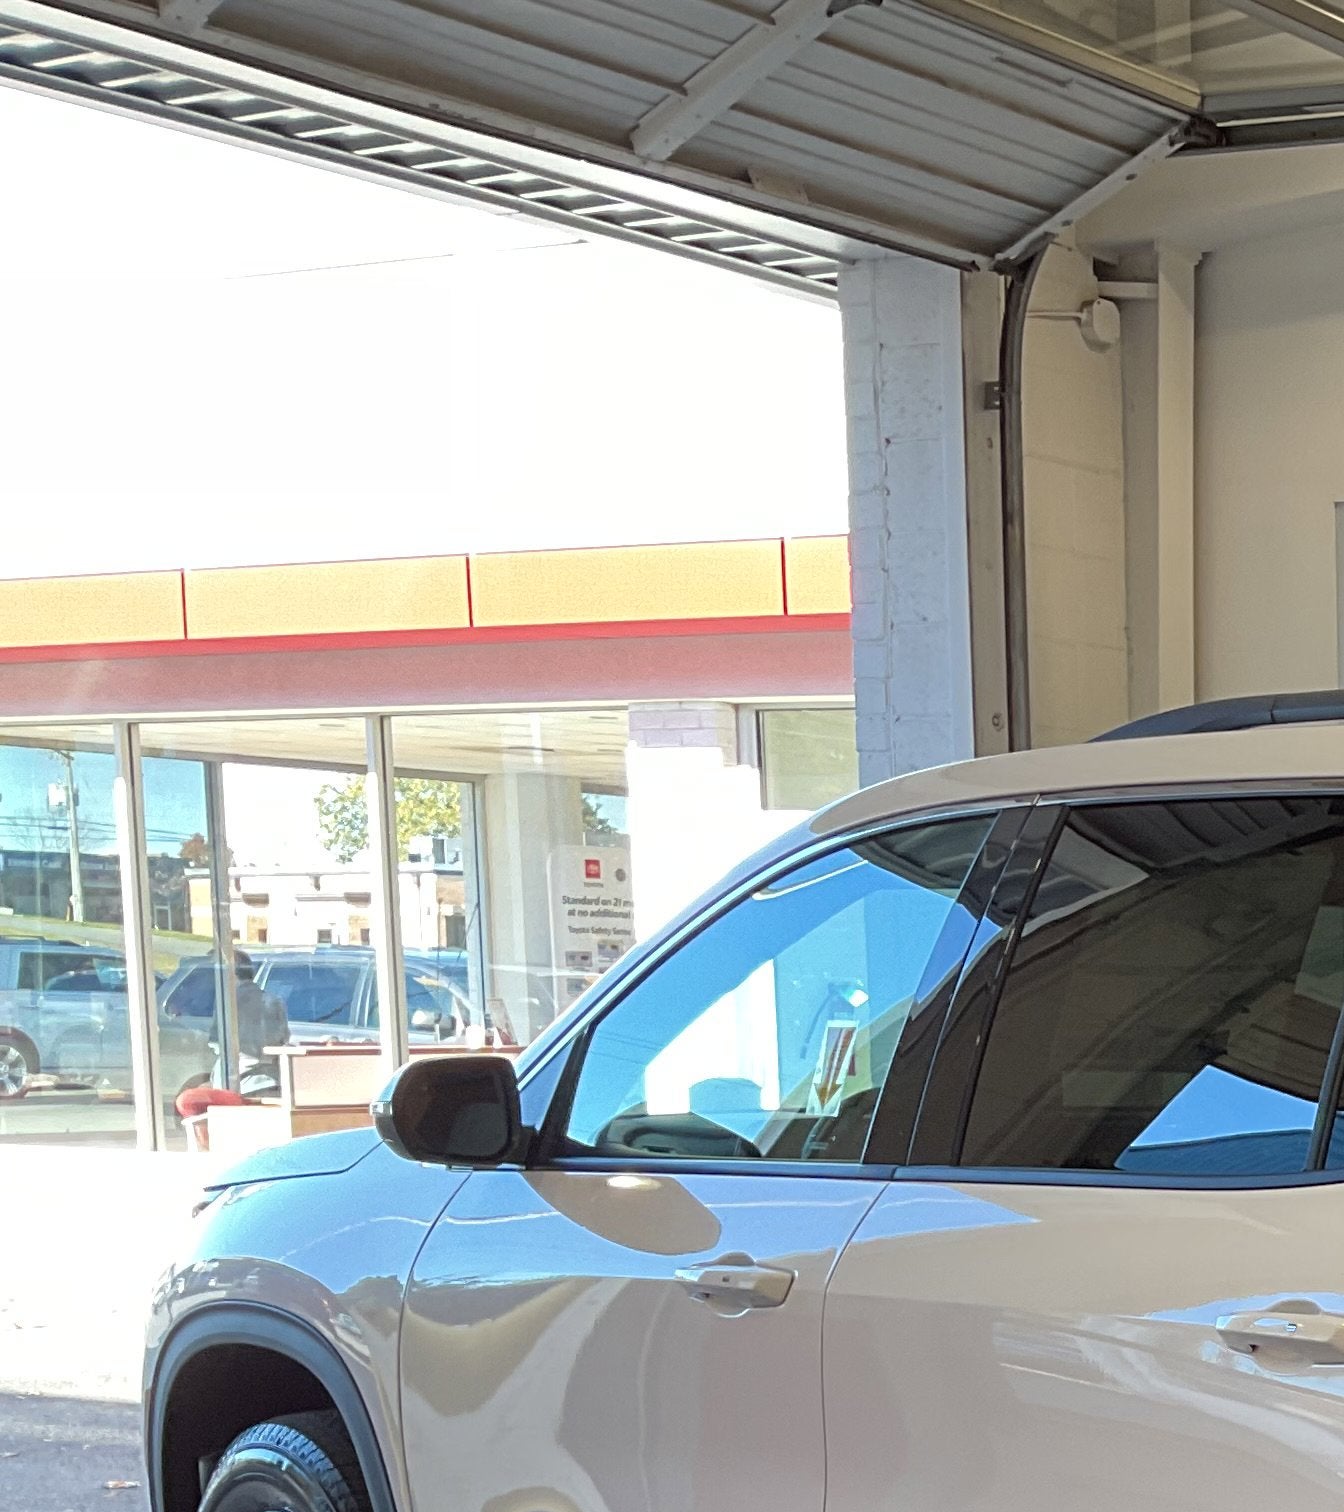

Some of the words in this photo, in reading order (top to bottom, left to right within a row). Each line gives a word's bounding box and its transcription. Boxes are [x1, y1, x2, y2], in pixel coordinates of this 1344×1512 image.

[562, 896, 600, 906] Standard
[613, 897, 622, 907] 21
[567, 908, 576, 917] at
[577, 909, 588, 918] no
[590, 909, 631, 920] additional
